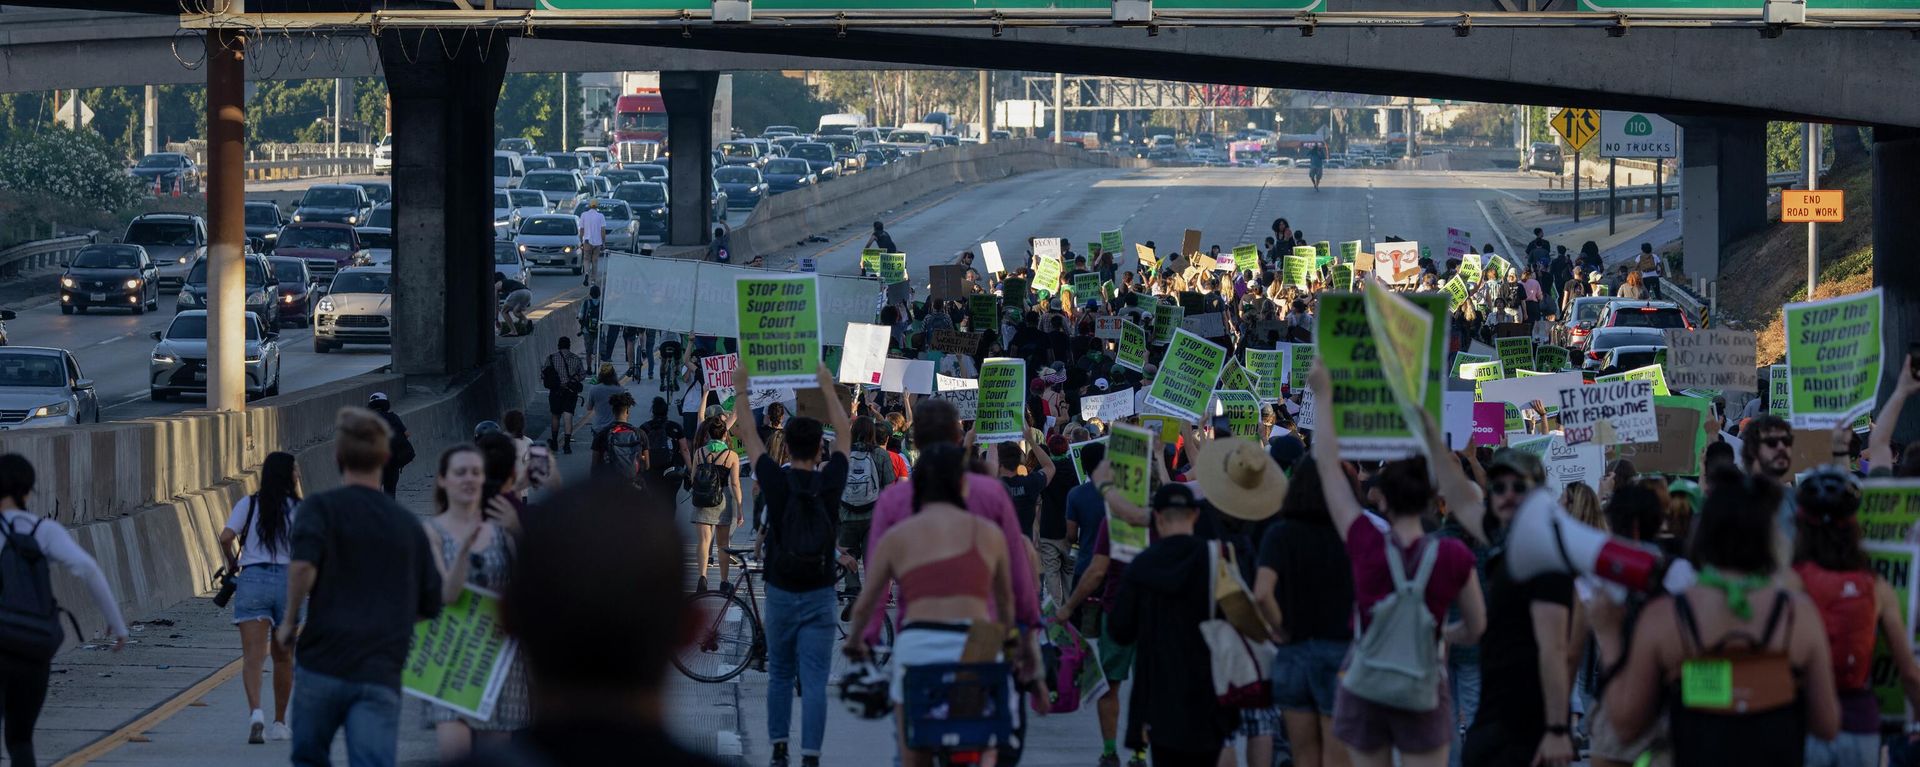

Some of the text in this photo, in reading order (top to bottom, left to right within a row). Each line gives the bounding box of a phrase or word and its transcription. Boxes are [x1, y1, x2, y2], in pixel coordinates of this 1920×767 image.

[1630, 121, 1646, 133] 110
[1606, 143, 1671, 152] NO TRUCKS
[1803, 195, 1821, 204] END
[1787, 208, 1838, 216] ROAD WORK
[747, 283, 804, 296] STOP the
[746, 299, 807, 314] Supreme
[759, 315, 796, 329] Court
[1802, 303, 1868, 326] STOP the
[1124, 332, 1137, 345] ROE
[1801, 321, 1871, 345] Supreme
[748, 343, 806, 356] Abortion
[1181, 337, 1217, 359] STOP the
[1816, 340, 1859, 361] Court
[705, 356, 726, 371] NOT
[757, 358, 804, 374] Rights!
[1175, 349, 1214, 370] Supreme
[1674, 351, 1695, 367] NO
[1000, 367, 1016, 377] the
[1180, 362, 1204, 378] Court
[1162, 378, 1202, 398] Abortion
[1804, 370, 1868, 392] Abortion
[986, 391, 1009, 401] Court
[1162, 389, 1196, 409] Rights!
[1332, 384, 1394, 404] Aborti
[1560, 382, 1651, 409] IF YOU CUT OFF
[1227, 404, 1255, 419] ROE ?
[1771, 399, 1789, 409] HEL
[979, 409, 1015, 420] Abortion
[1344, 410, 1408, 431] Rights
[1505, 408, 1519, 419] NO!
[1562, 409, 1581, 425] MY
[981, 420, 1013, 432] Rights!
[434, 614, 461, 667] Court
[450, 613, 492, 692] Abortion
